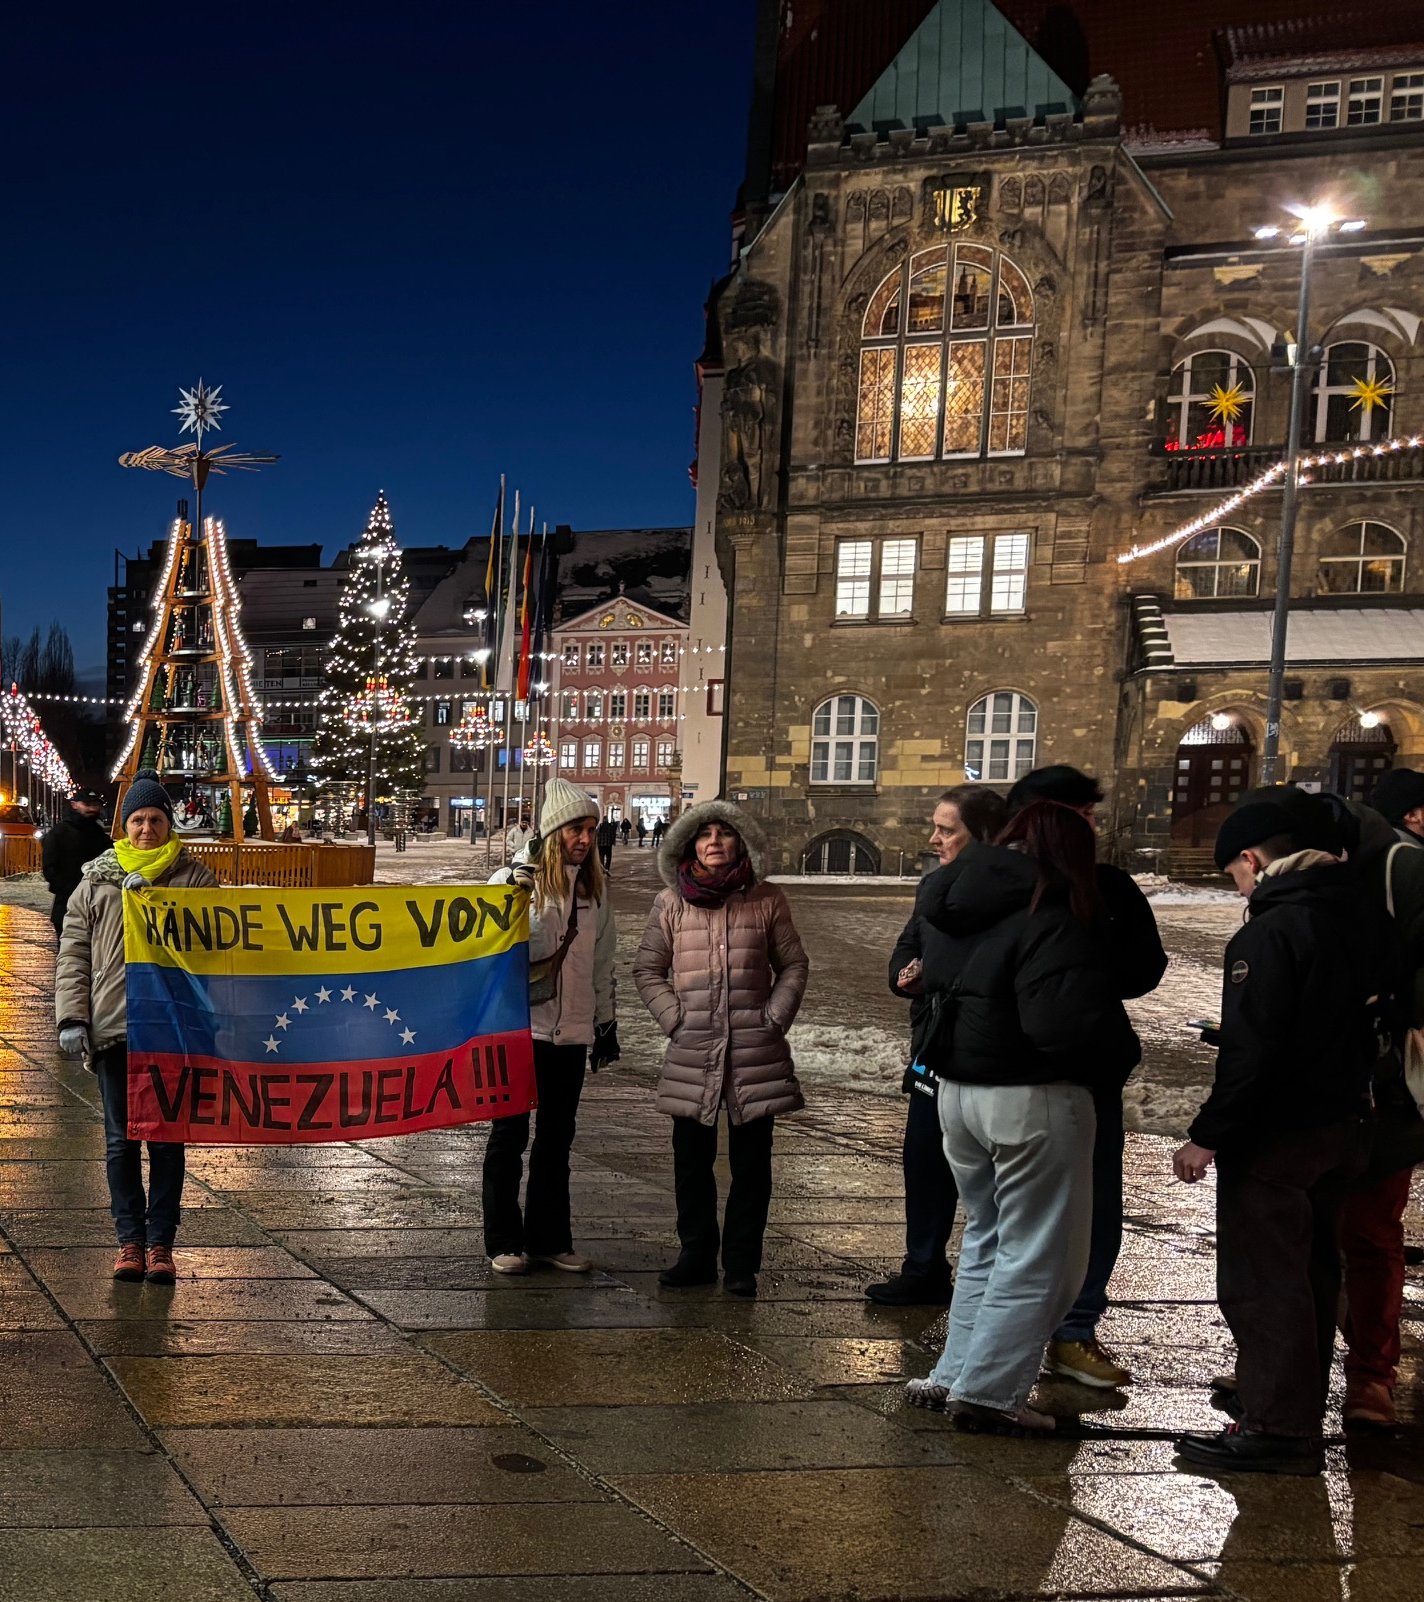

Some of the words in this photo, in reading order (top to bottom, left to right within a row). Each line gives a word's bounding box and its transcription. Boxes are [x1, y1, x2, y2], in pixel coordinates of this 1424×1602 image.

[142, 902, 264, 952] HÄNDE
[276, 901, 382, 952] WEG
[405, 894, 515, 948] VON
[148, 1058, 461, 1130] VENEZUELA
[471, 1045, 510, 1104] !!!
